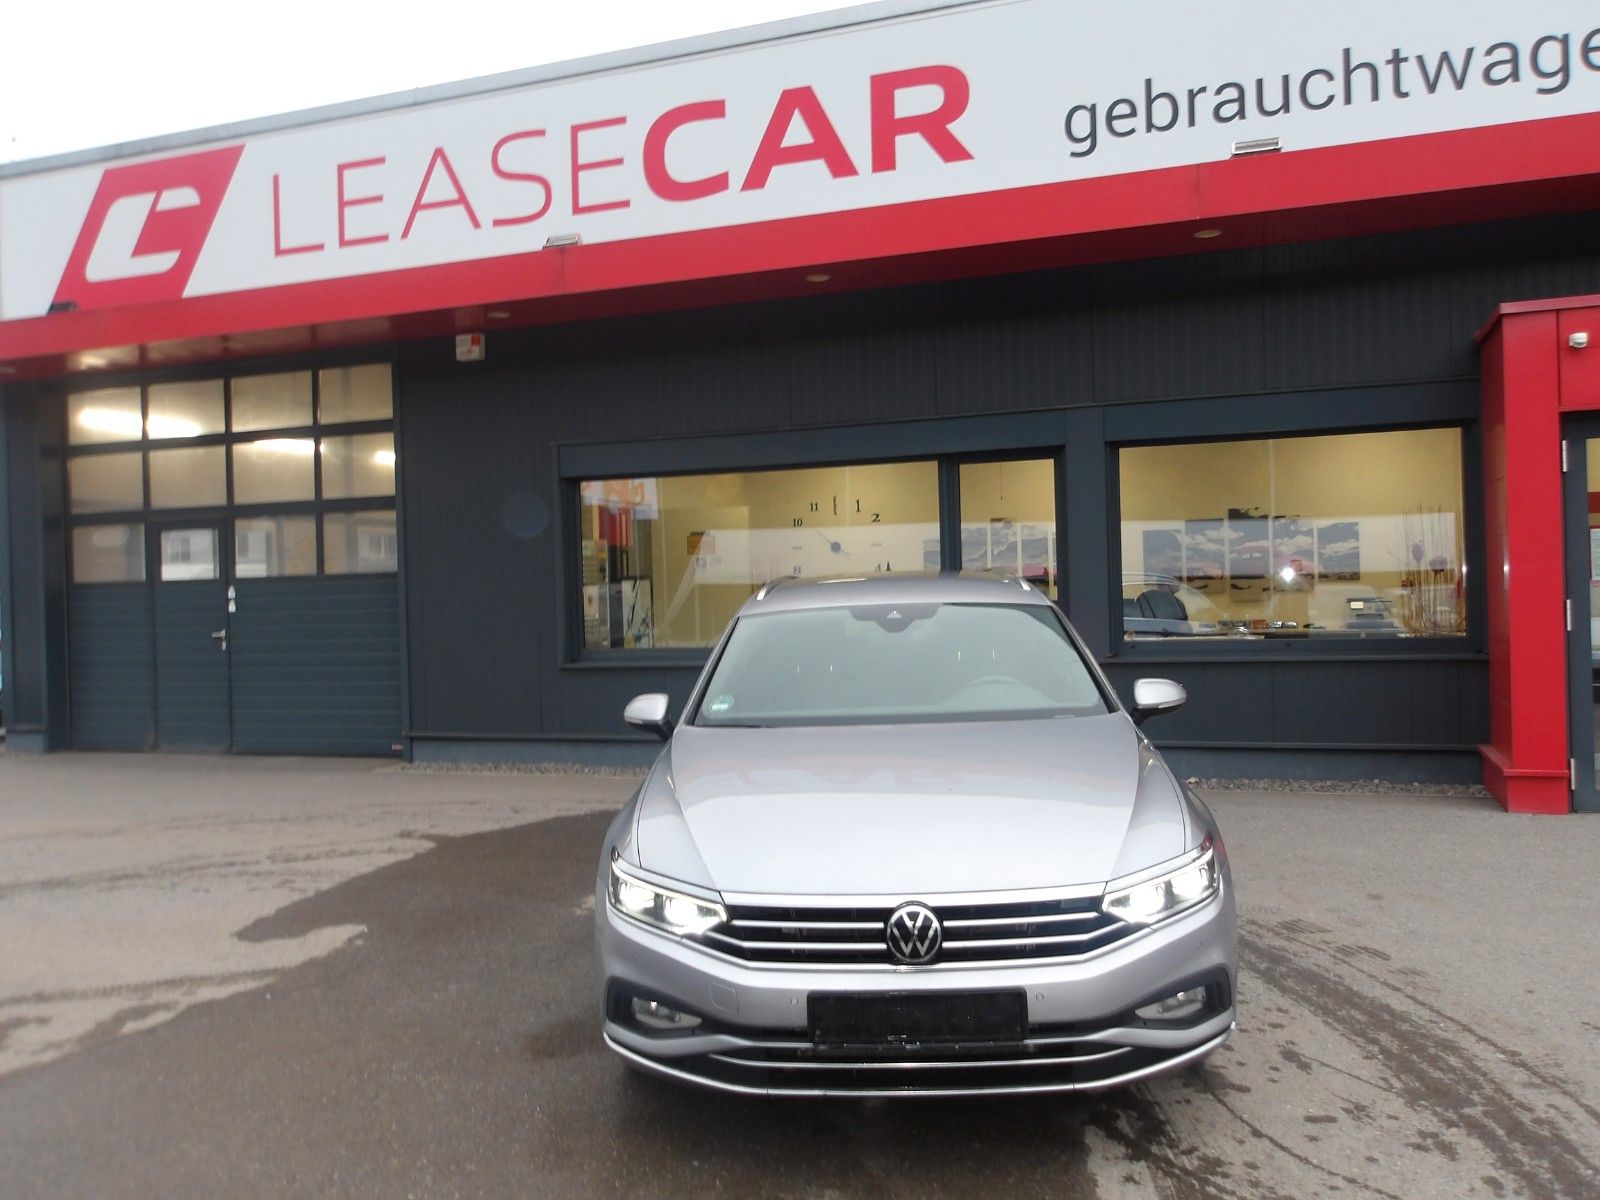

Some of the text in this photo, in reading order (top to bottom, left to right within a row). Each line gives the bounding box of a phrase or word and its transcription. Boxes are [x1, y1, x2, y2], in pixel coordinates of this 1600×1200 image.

[273, 64, 976, 257] LEASECAR
[792, 518, 803, 528] 10
[871, 513, 880, 523] 2
